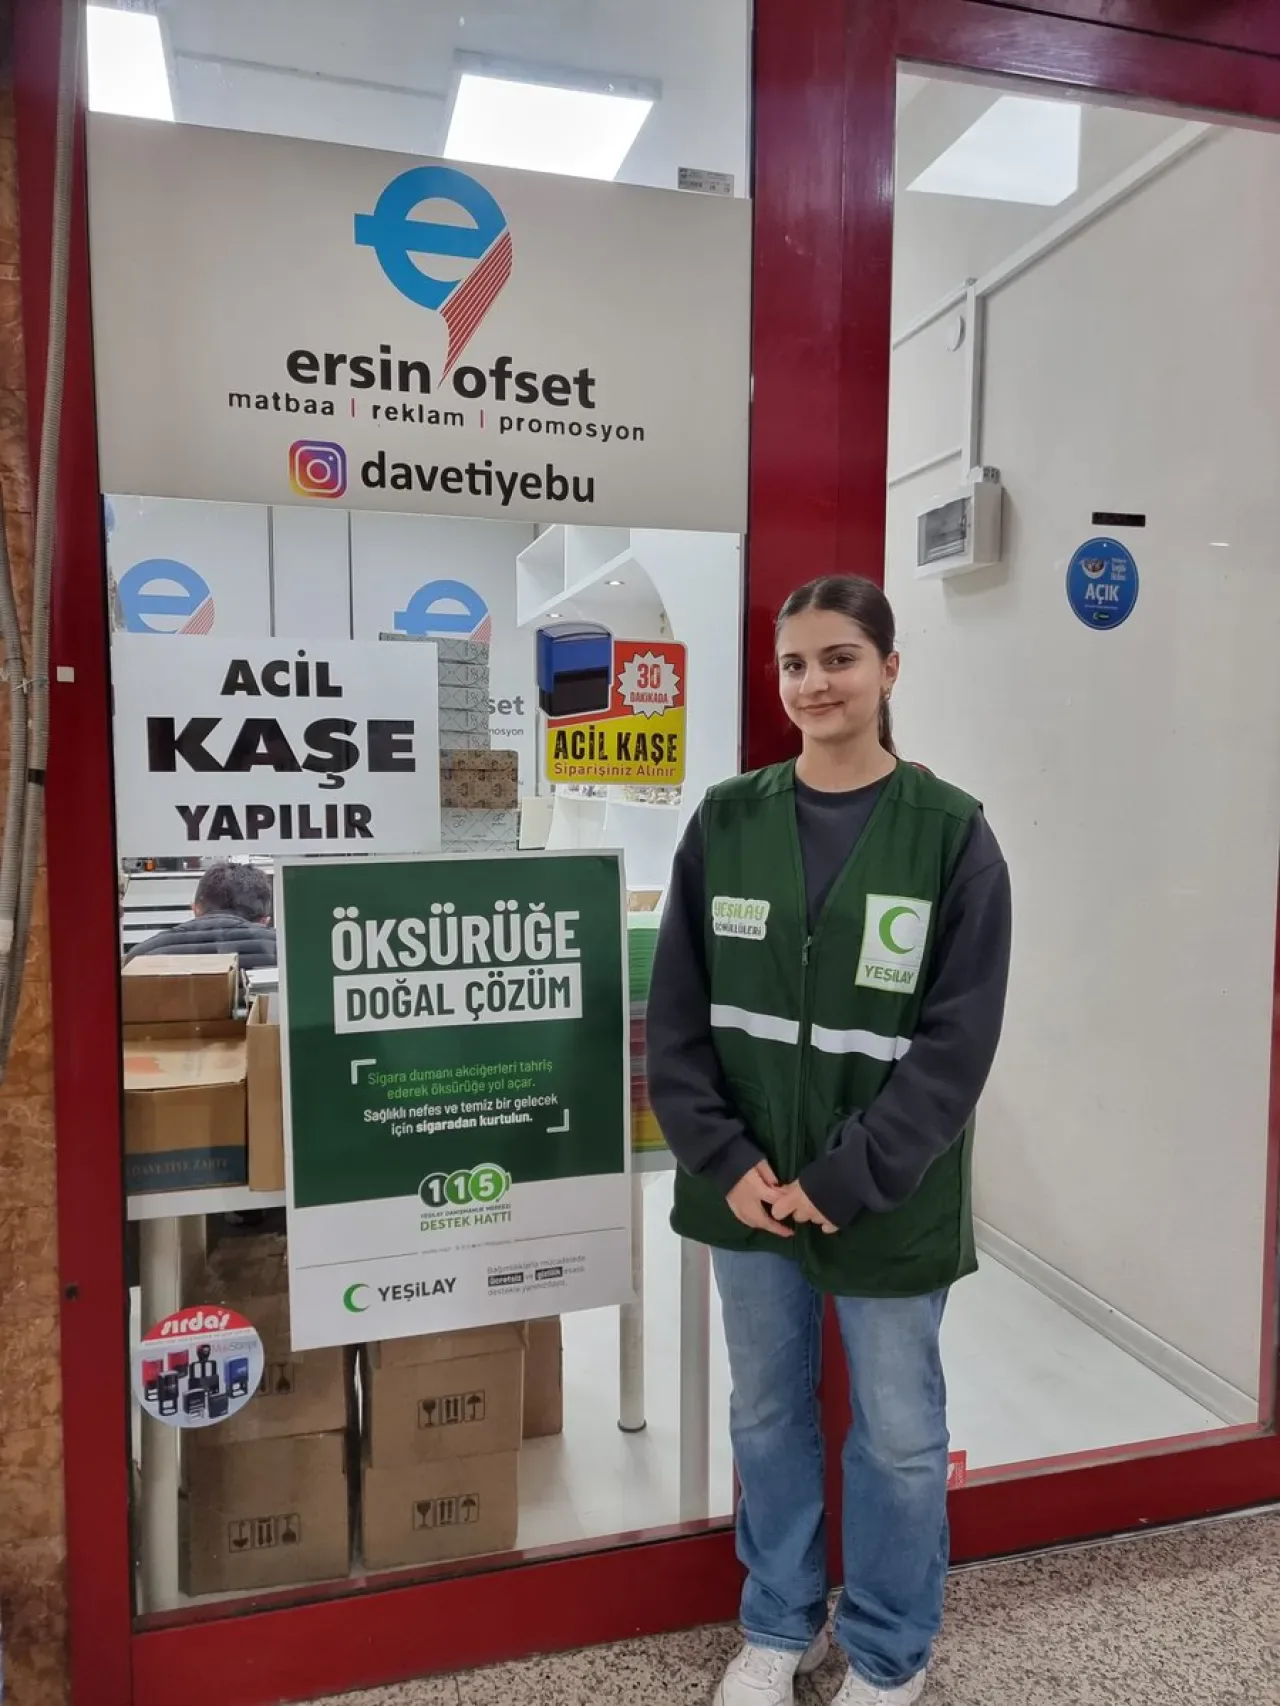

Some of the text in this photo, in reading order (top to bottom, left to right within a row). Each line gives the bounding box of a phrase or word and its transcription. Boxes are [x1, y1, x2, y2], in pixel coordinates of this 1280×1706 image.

[286, 345, 596, 408] ersin ofset
[229, 391, 645, 443] matbaa reklam promosyon
[361, 451, 595, 506] davetiyebu
[1084, 583, 1120, 605] AÇIK
[220, 649, 343, 698] ACİL
[637, 663, 662, 689] 30
[147, 716, 416, 789] KAŞE
[553, 725, 678, 765] ACİL KAŞE
[554, 762, 676, 777] Siparişiniz Alınır
[176, 803, 375, 841] YAPILIR
[331, 899, 581, 971] ÖKSÜRÜĞE
[346, 968, 571, 1022] DOĞAL ÇÖZÜM
[368, 1059, 553, 1086] Sigara dumanı akciğerleri tahriş
[387, 1077, 536, 1099] ederek öksürüğe yol açar.
[363, 1093, 558, 1123] Sağlıklı nefes ve temiz bir gelecek
[391, 1111, 533, 1136] için sigaradan kurtulun.
[420, 1211, 512, 1232] DESTEK HATTI
